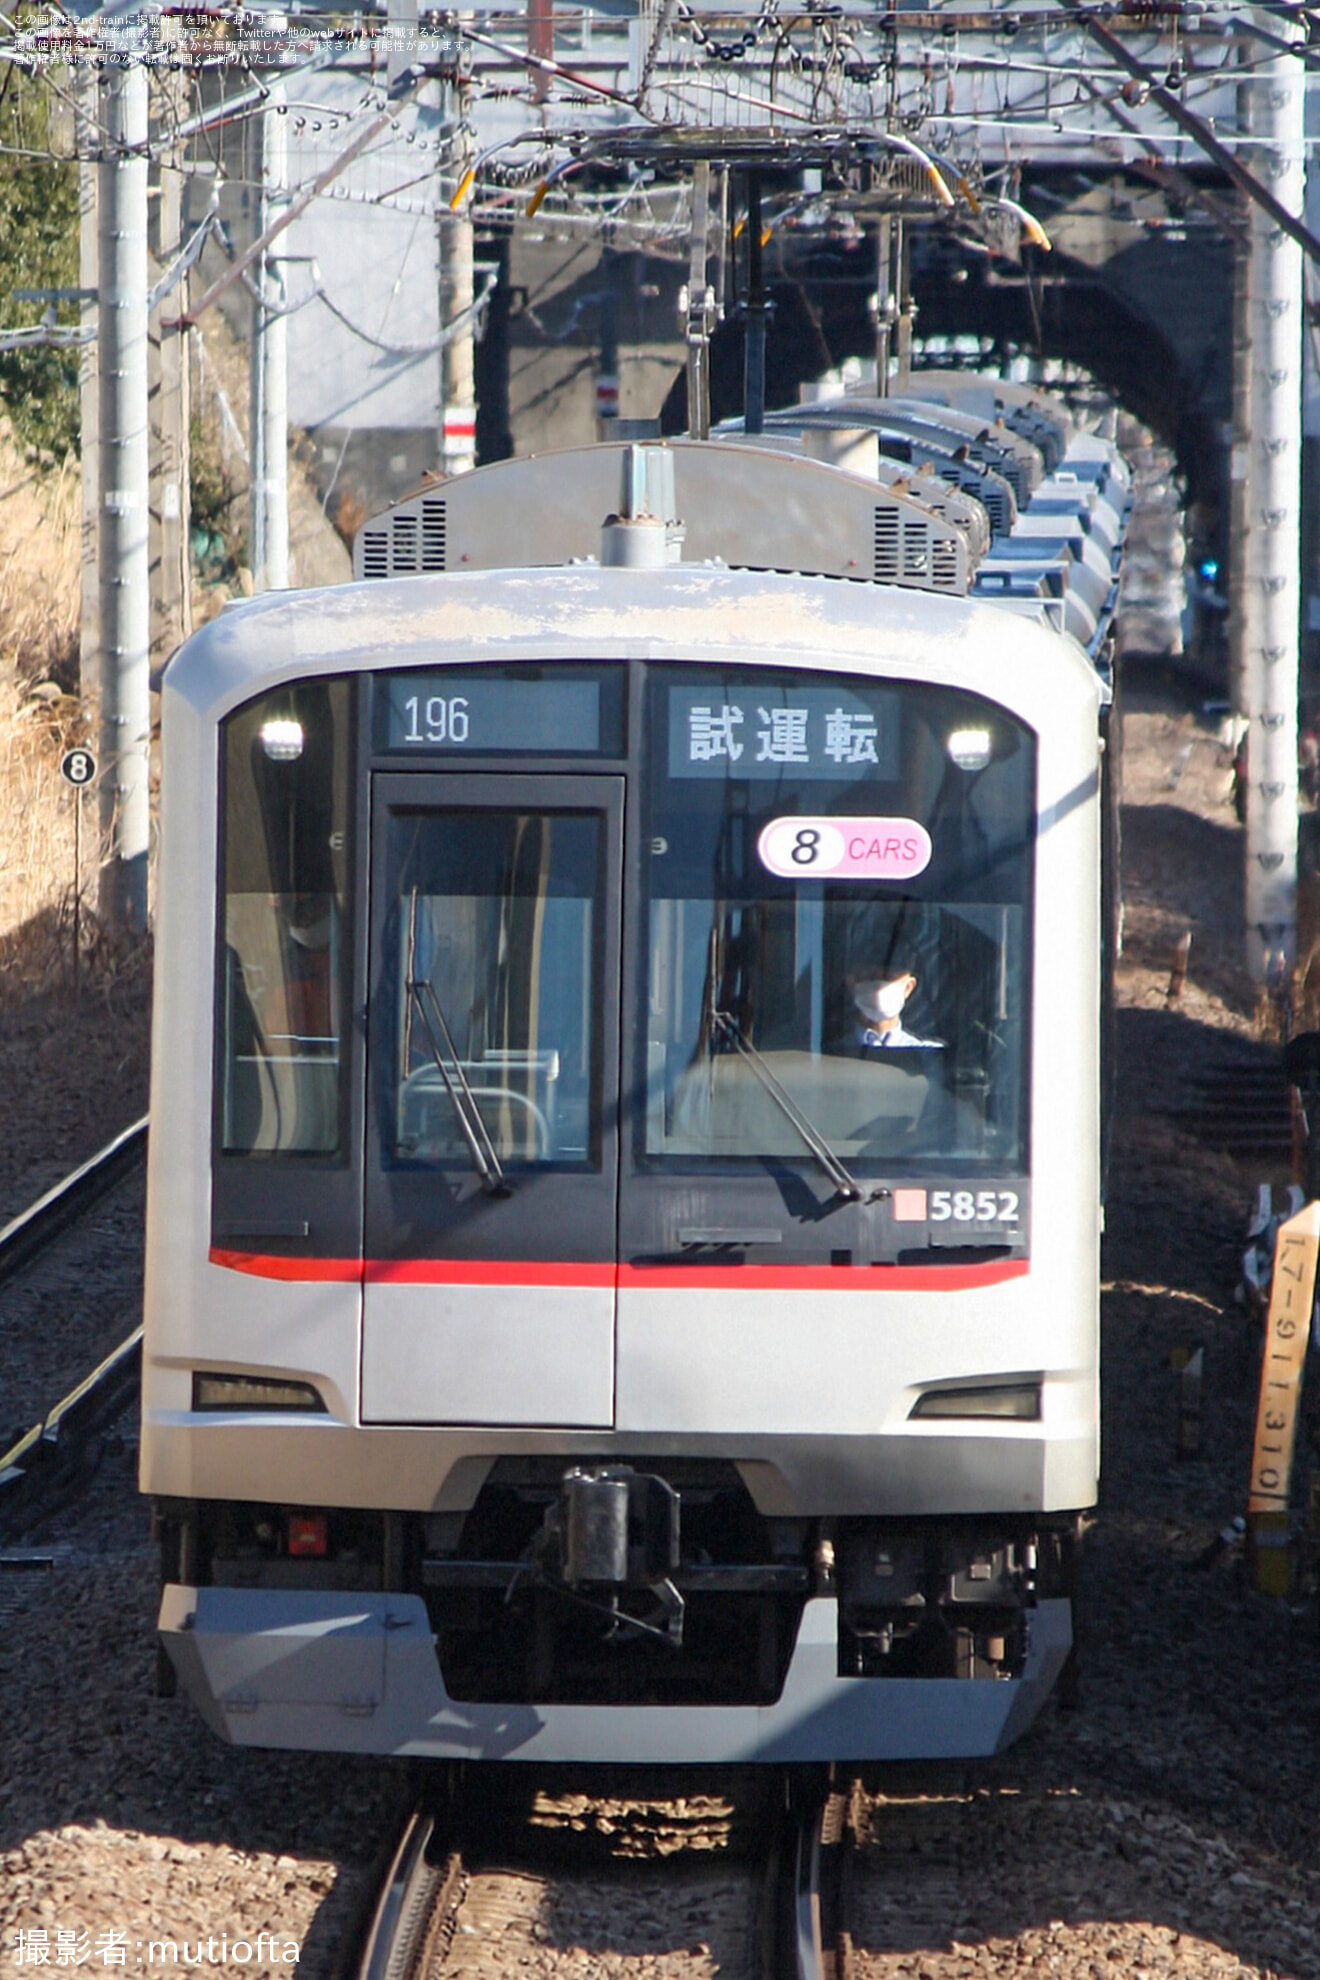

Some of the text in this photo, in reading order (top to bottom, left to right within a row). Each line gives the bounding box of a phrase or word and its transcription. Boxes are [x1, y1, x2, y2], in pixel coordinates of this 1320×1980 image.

[404, 697, 469, 742] 196
[689, 706, 879, 763] 試運転
[70, 754, 87, 781] 8
[791, 829, 918, 864] 8 CARS
[930, 1191, 1019, 1221] 5852
